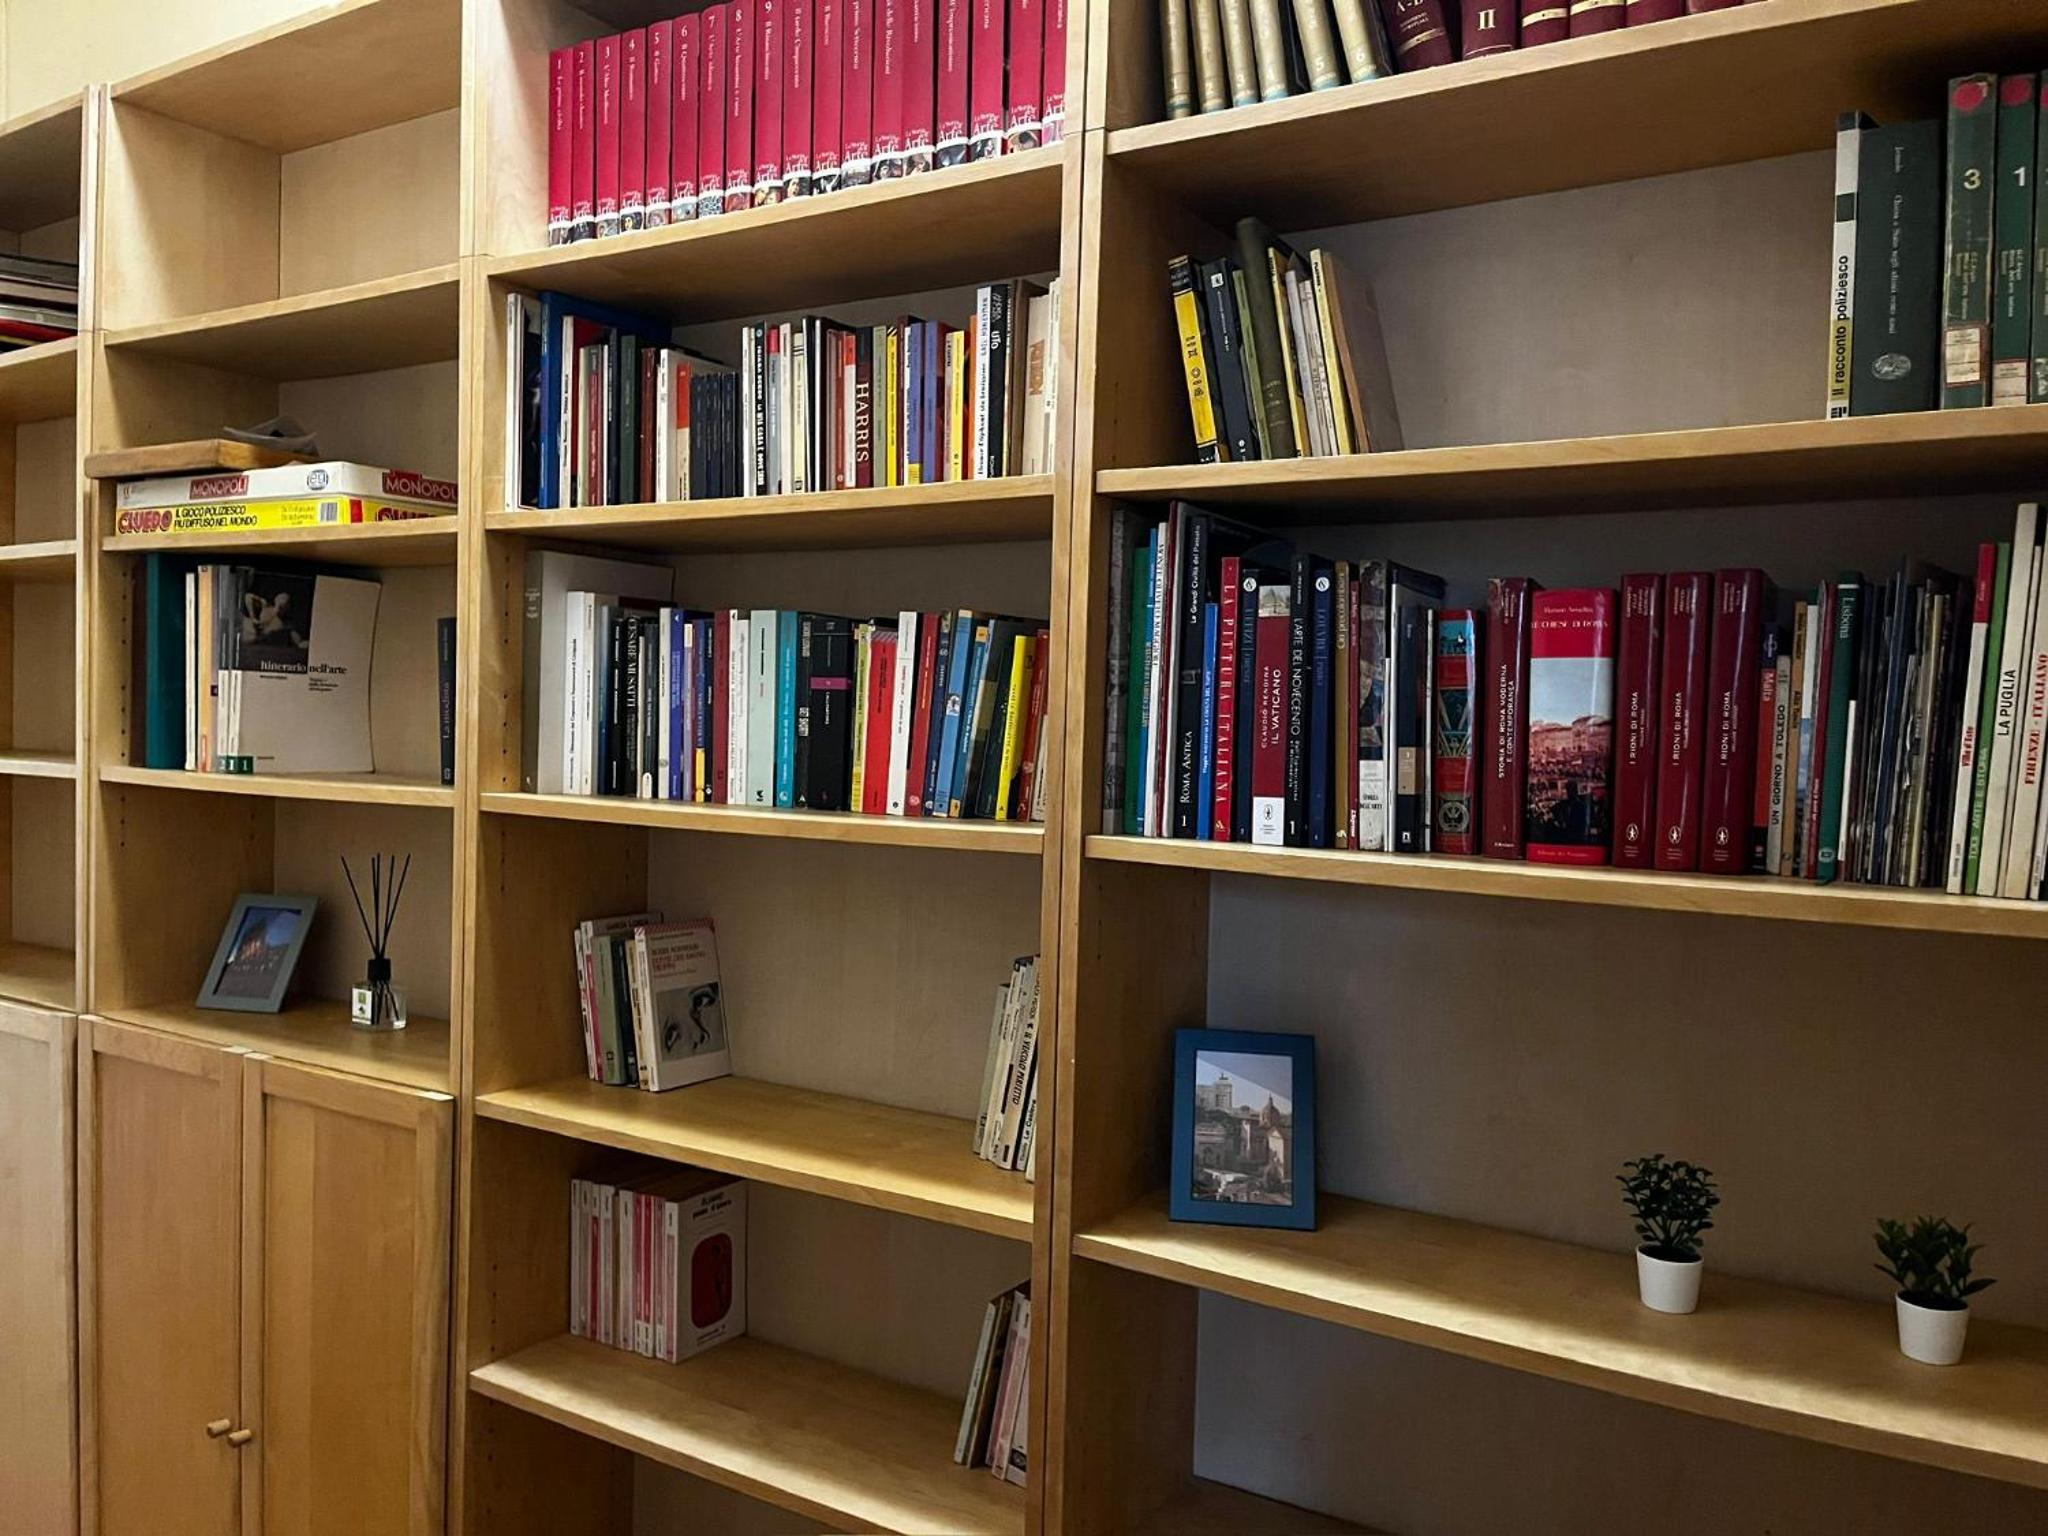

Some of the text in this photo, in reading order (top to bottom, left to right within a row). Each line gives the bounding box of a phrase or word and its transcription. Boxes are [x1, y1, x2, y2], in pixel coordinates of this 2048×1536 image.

[735, 9, 741, 21] 8
[765, 1, 771, 12] 9
[681, 25, 687, 36] 6
[708, 15, 714, 27] 7
[629, 38, 635, 49] 4
[654, 32, 658, 43] 5
[1963, 168, 1981, 190] 3
[2014, 166, 2026, 187] 1
[1836, 254, 1850, 321] poliziesco
[1834, 325, 1847, 382] racconto
[854, 382, 870, 462] HARRIS
[192, 476, 247, 499] MONOPOLI
[118, 510, 172, 534] CLUEDO
[182, 507, 204, 517] GIOCO
[205, 505, 246, 517] POLIZIESCO
[186, 518, 216, 527] DIFFUSO
[216, 517, 228, 526] NEL
[231, 515, 257, 526] MONDO
[1156, 543, 1164, 574] MONTE
[1155, 578, 1163, 615] OLIVETO
[1316, 608, 1326, 649] LOUVRE
[1839, 596, 1854, 639] Lisbona
[1292, 617, 1303, 645] L'ARTE
[261, 660, 347, 675] Itinerario nell'arte
[626, 616, 636, 706] CESARE MUSATTI
[1292, 649, 1302, 665] DEL
[1215, 585, 1235, 803] LA PITTURA ITALIANA
[1499, 664, 1507, 706] MODERNA
[1762, 672, 1774, 701] Malta
[1271, 668, 1281, 744] IL VATICANO
[1289, 668, 1302, 734] NOVECENTO
[1630, 691, 1638, 717] ROMA
[1674, 692, 1682, 717] ROMA
[1722, 691, 1731, 717] ROMA
[1997, 669, 2015, 735] LA PUGLIA
[1503, 680, 1516, 754] CONTEMPORANEA
[1630, 720, 1637, 729] DI
[1674, 721, 1681, 730] DI
[1722, 720, 1729, 729] DI
[1775, 704, 1785, 746] TOLEDO
[2024, 654, 2047, 784] FIRENZE ITALIANO
[1499, 735, 1505, 745] DI
[1629, 732, 1637, 758] RIONI
[1672, 733, 1680, 759] RIONI
[1720, 733, 1728, 759] RIONI
[1961, 750, 1970, 766] Villa
[1976, 747, 1987, 786] STORIA
[1772, 763, 1782, 804] GIORNO
[1771, 810, 1779, 825] UN
[1971, 799, 1981, 828] ARTE
[1968, 836, 1978, 859] TODI
[1018, 1040, 1030, 1069] VEICOLO
[1011, 1069, 1025, 1104] PERFETTO
